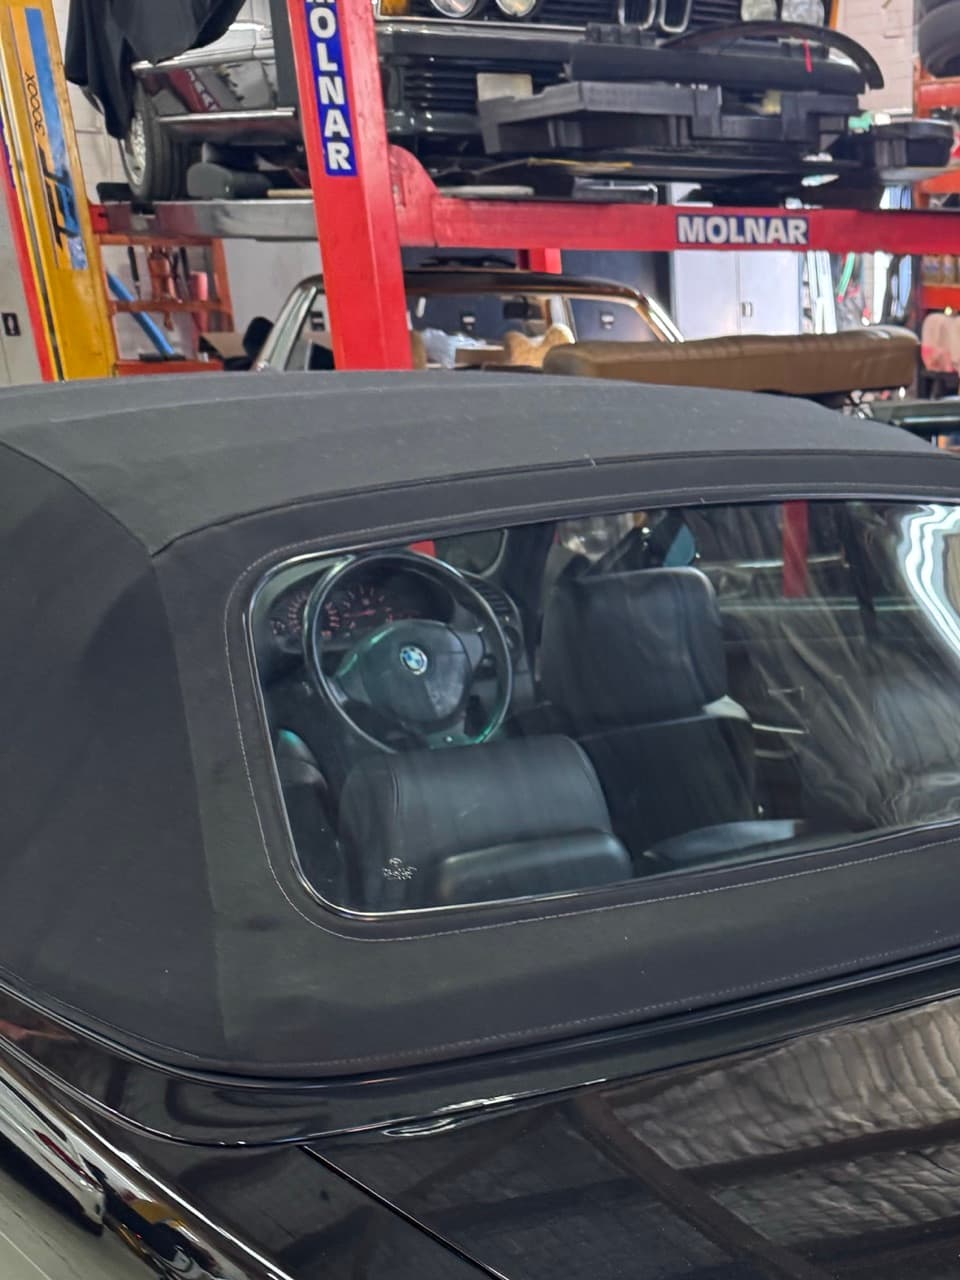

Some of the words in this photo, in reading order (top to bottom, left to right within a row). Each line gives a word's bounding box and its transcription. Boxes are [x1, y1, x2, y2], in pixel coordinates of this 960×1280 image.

[25, 72, 45, 136] 3000X
[305, 0, 352, 170] OLNAR
[677, 215, 808, 244] MOLNAR
